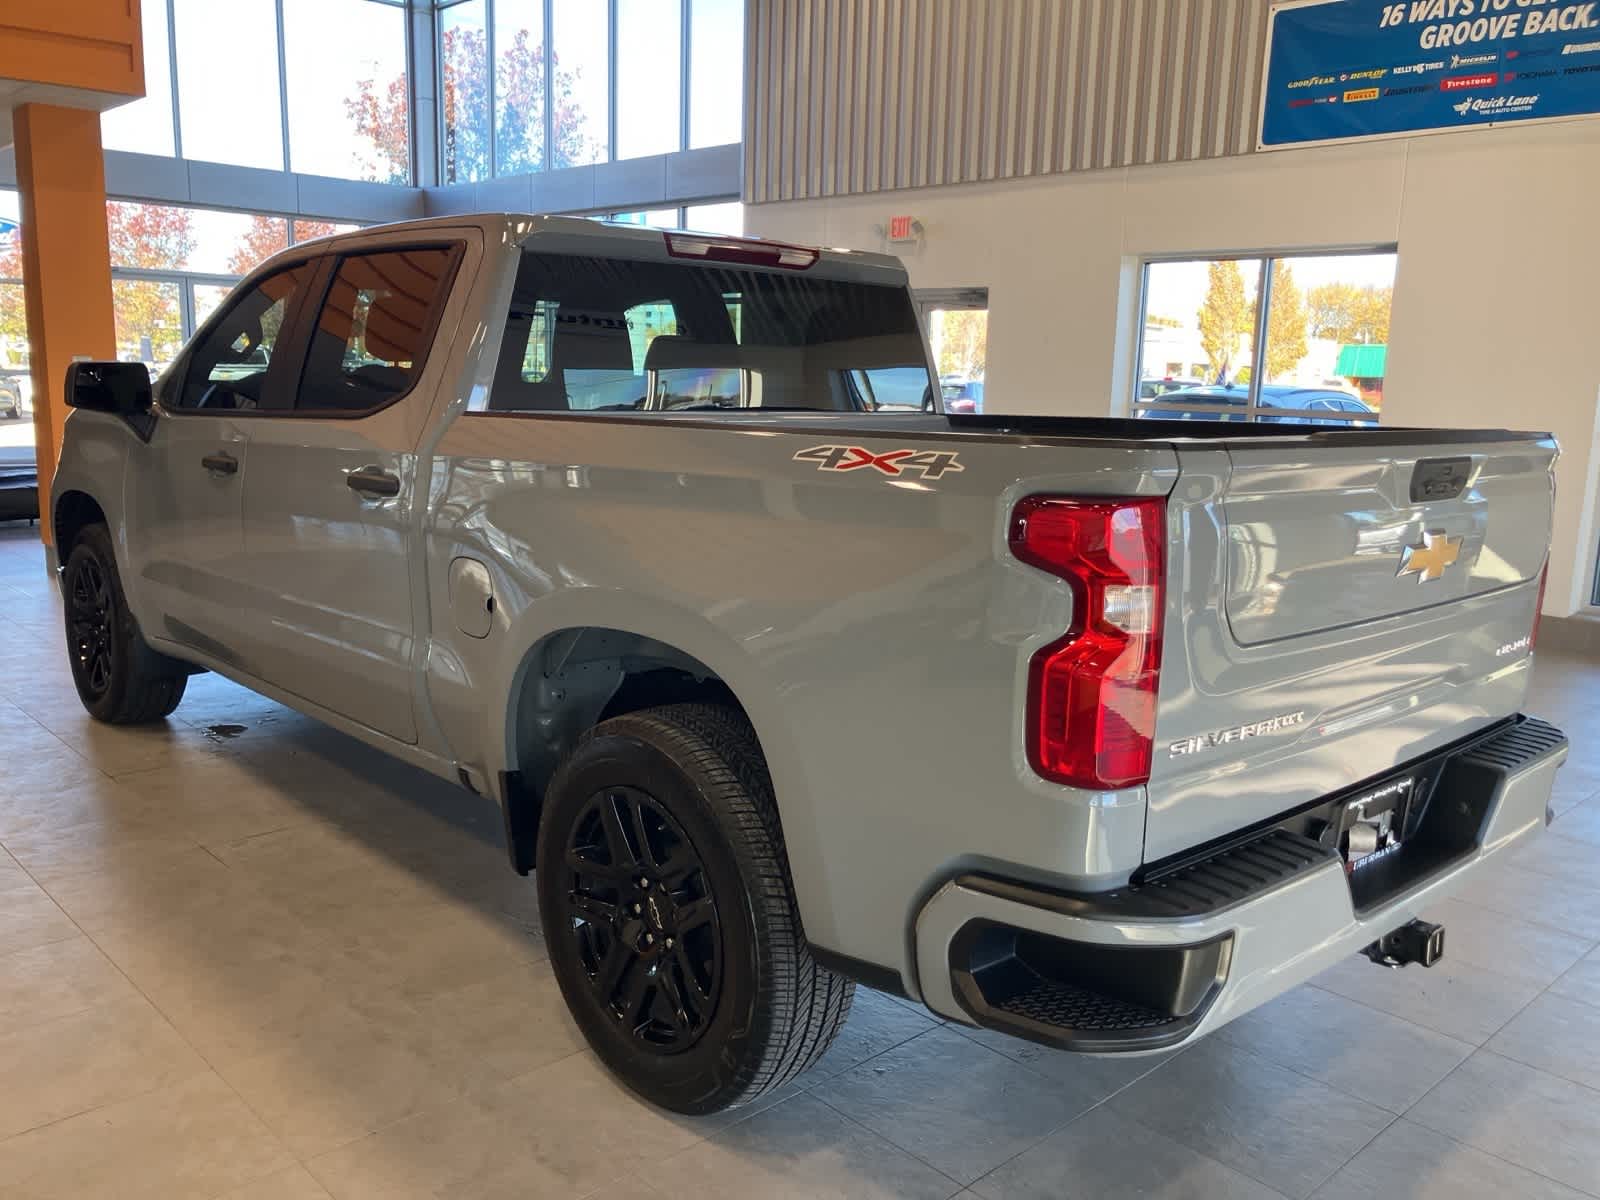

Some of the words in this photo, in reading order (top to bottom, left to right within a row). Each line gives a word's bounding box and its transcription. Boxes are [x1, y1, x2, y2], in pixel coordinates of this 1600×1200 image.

[1380, 4, 1406, 28] 16
[1409, 0, 1475, 23] WAYS
[1420, 14, 1521, 49] GROOVE
[1522, 3, 1599, 36] BACK.
[1288, 76, 1336, 88] GOODYEAR
[1350, 68, 1388, 80] DUNLOP
[1447, 78, 1493, 89] Firestone
[1472, 97, 1506, 111] Quick
[1506, 94, 1539, 107] Lane
[891, 215, 912, 238] EXIT
